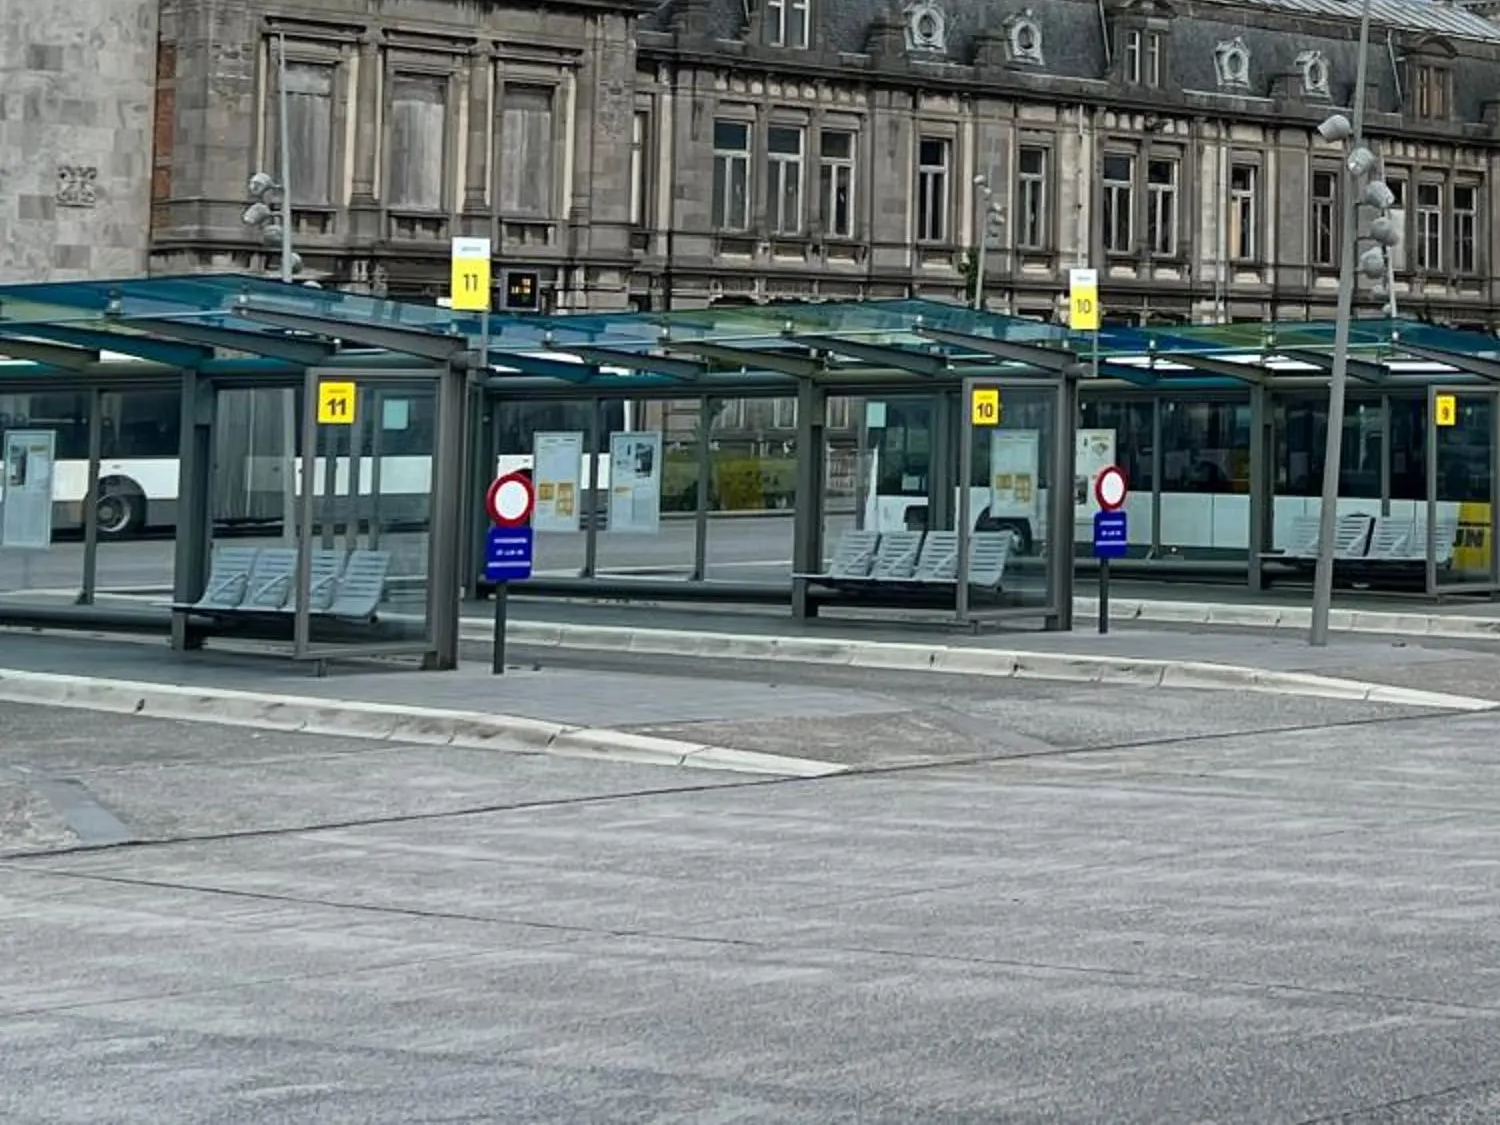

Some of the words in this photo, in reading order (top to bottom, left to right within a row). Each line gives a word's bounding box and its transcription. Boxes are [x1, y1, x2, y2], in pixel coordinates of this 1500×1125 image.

[462, 273, 479, 292] 11
[1076, 299, 1093, 314] 10
[326, 398, 347, 416] 11
[976, 403, 993, 418] 10
[1441, 405, 1450, 421] 9
